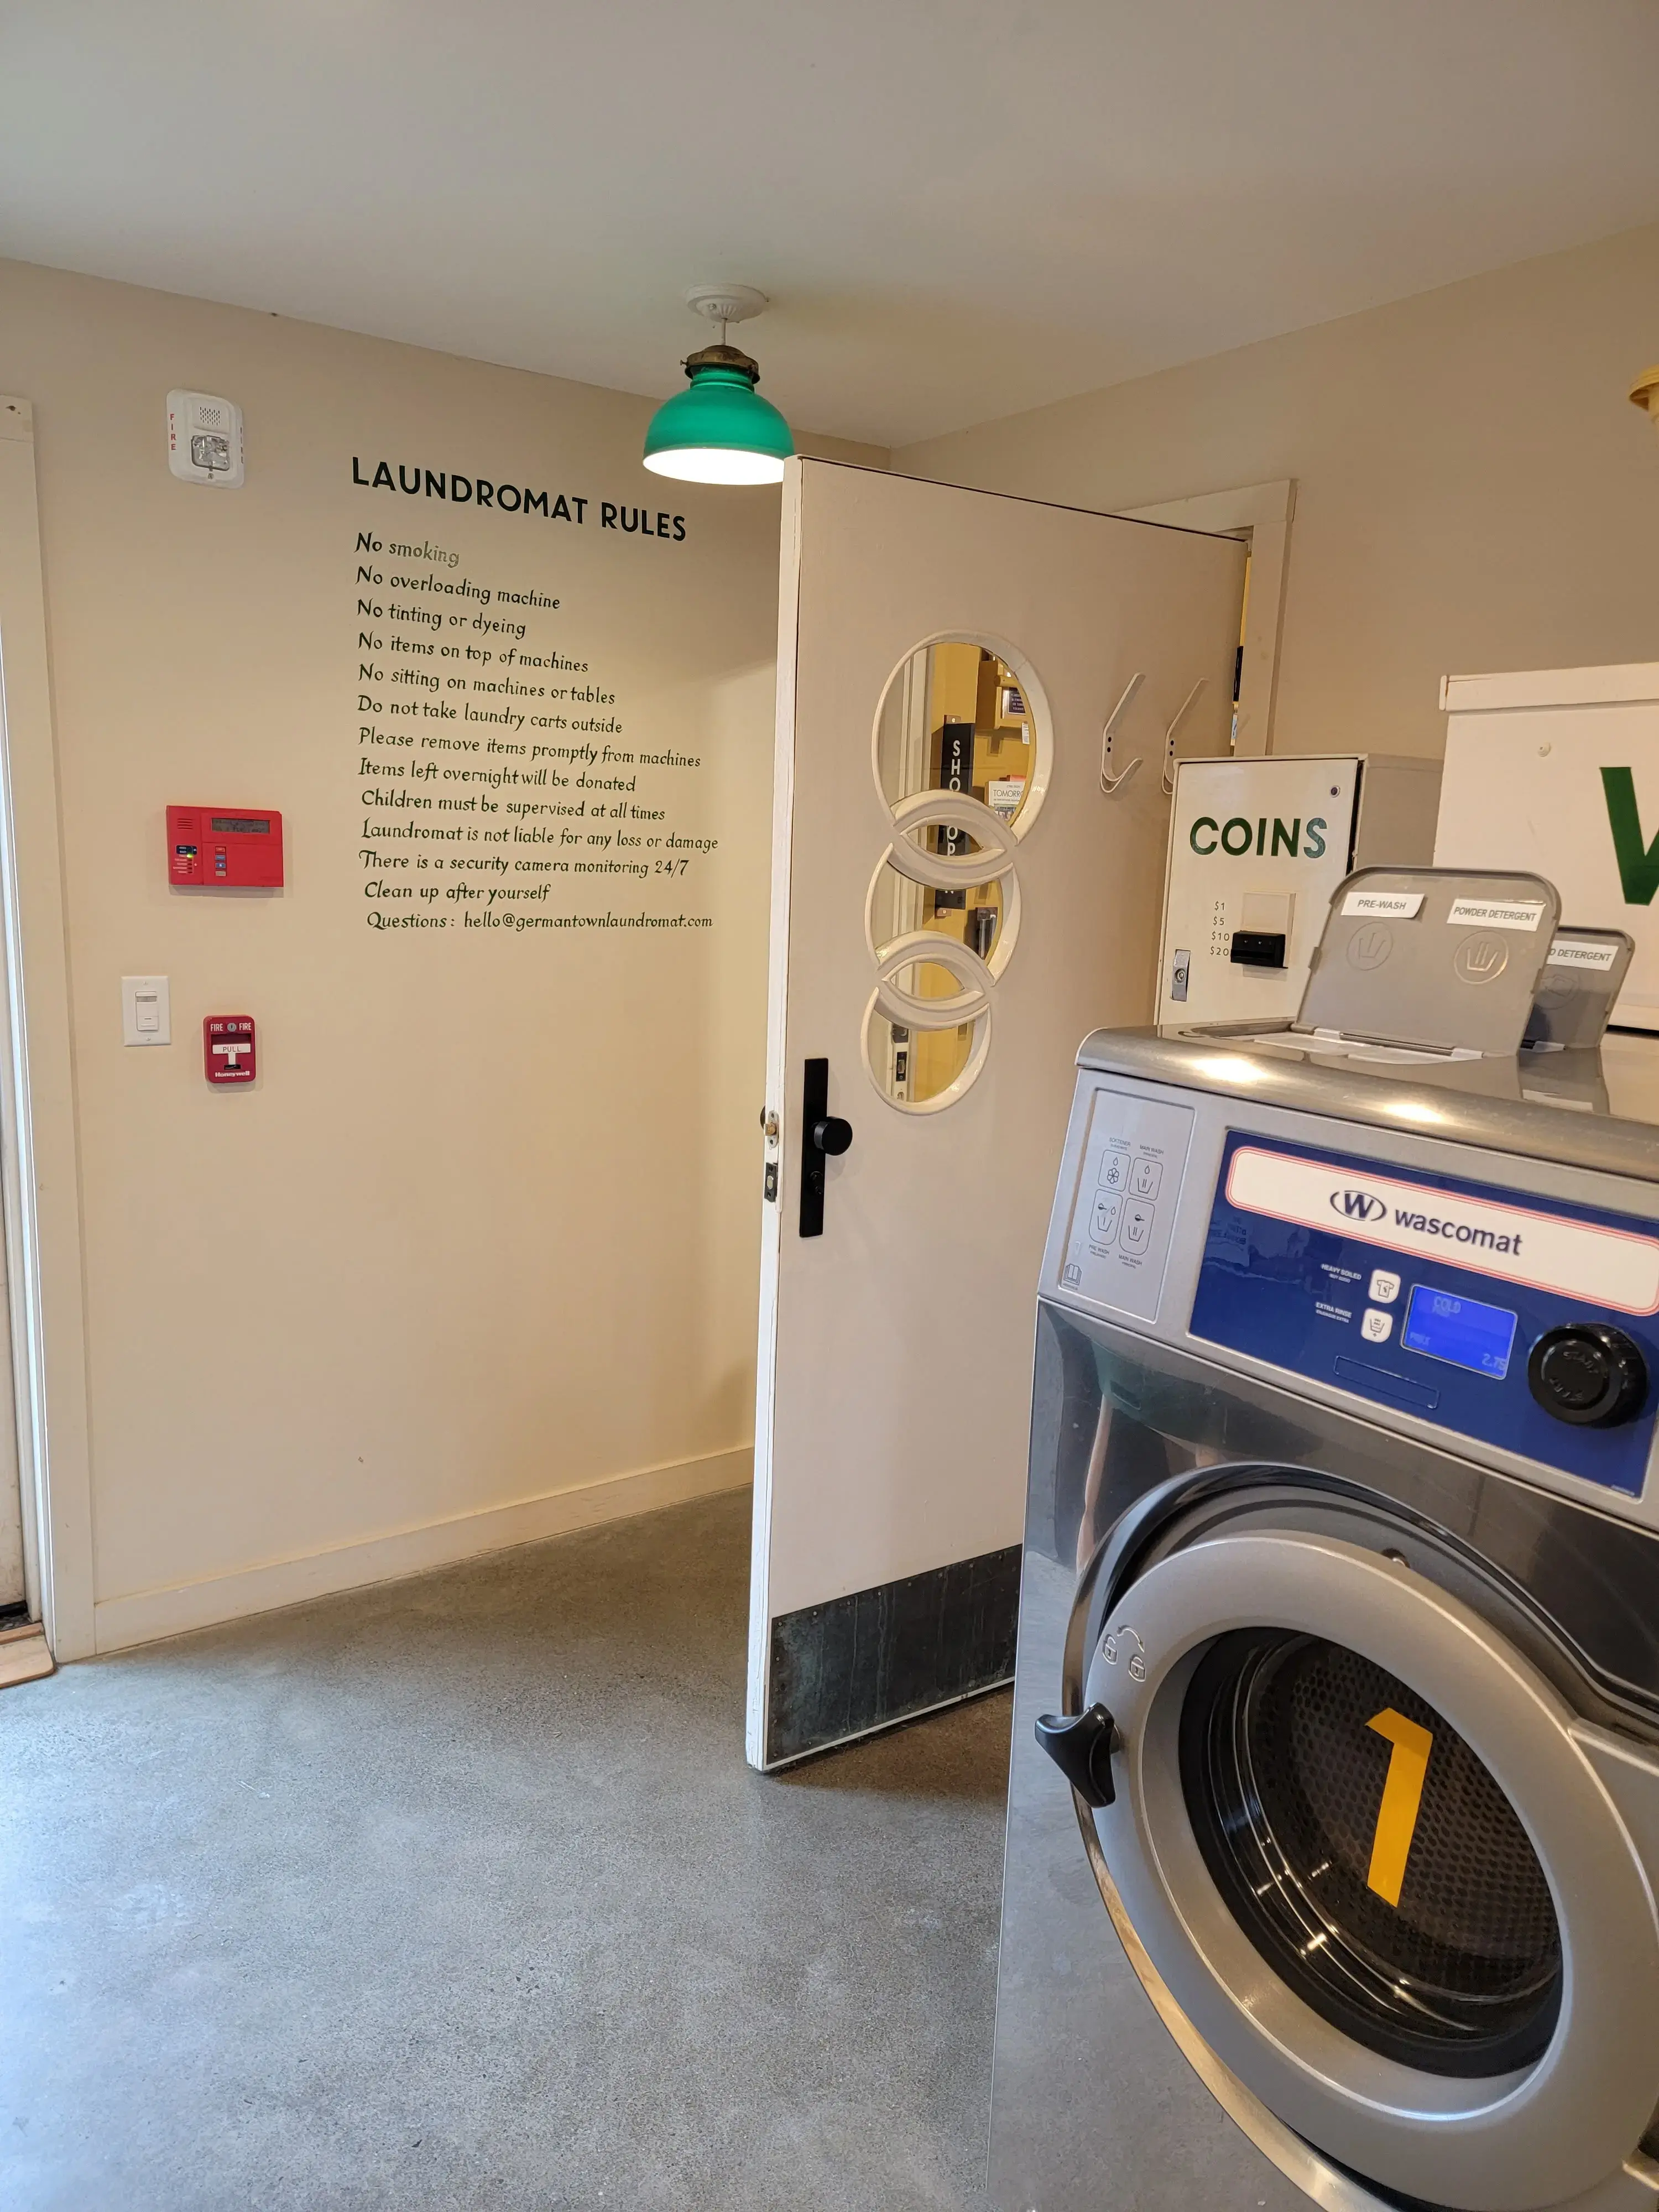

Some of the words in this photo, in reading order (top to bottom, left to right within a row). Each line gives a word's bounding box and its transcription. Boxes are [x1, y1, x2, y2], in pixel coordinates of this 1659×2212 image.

[353, 457, 588, 524] LAUNDROMAT
[602, 502, 686, 541] RULES
[354, 531, 382, 552] No
[389, 541, 459, 568] smoking
[355, 565, 383, 585] No
[390, 573, 491, 606] overloading
[498, 589, 560, 609] machine
[357, 598, 383, 618] No
[388, 604, 442, 631] tinting
[449, 616, 467, 627] or
[473, 612, 526, 640] dyeing
[358, 631, 382, 650] No
[391, 635, 434, 655] items
[441, 646, 459, 658] on
[465, 645, 491, 667] top
[499, 648, 517, 666] of
[520, 651, 588, 672] machines
[358, 663, 383, 681] No
[391, 669, 440, 692] sitting
[447, 679, 466, 690] on
[473, 677, 545, 696] machines
[551, 689, 567, 699] or
[570, 685, 615, 704] tables
[357, 695, 382, 712] Do
[390, 702, 419, 716] not
[422, 701, 457, 718] take
[465, 702, 525, 732] laundry
[531, 715, 567, 729] carts
[572, 717, 623, 733] outside
[358, 726, 413, 747] Please
[421, 738, 480, 751] remove
[487, 738, 526, 754] items
[530, 743, 598, 766] promptly
[601, 745, 634, 764] from
[640, 749, 701, 766] machines
[358, 758, 405, 776] Items
[411, 760, 439, 782] left
[444, 766, 519, 789] overnight
[521, 768, 547, 785] will
[552, 770, 568, 786] be
[576, 771, 636, 791] donated
[949, 740, 961, 791] SHO
[362, 788, 432, 808] Children
[439, 796, 478, 811] must
[481, 794, 498, 812] be
[507, 801, 585, 821] supervised
[591, 804, 606, 817] at
[610, 802, 627, 818] all
[630, 805, 665, 820] times
[361, 817, 464, 841] Laundromat
[467, 827, 478, 841] is
[484, 828, 510, 842] not
[514, 826, 554, 843] liable
[558, 828, 582, 847] for
[587, 835, 612, 852] any
[617, 830, 641, 846] loss
[647, 838, 662, 847] or
[666, 832, 718, 854] damage
[1190, 816, 1327, 859] COINS
[359, 850, 409, 869] There
[417, 854, 428, 869] is
[435, 859, 444, 869] a
[450, 857, 509, 876] security
[515, 861, 568, 872] camera
[575, 860, 649, 878] monitoring
[655, 858, 690, 878] 24/7
[365, 879, 412, 898] Clean
[420, 888, 439, 905] up
[446, 882, 484, 904] after
[486, 884, 551, 906] yourself
[1214, 901, 1225, 911] $1
[1357, 899, 1407, 910] PRE-WASH
[465, 911, 713, 932] hello@germantownlaundromat.com
[1213, 916, 1224, 926] $5
[1453, 906, 1487, 918] POWDER
[1489, 910, 1537, 922] DETERGENT
[1210, 946, 1229, 956] $20
[1211, 931, 1230, 941] $10
[1557, 950, 1613, 961] DETERGENT
[210, 1024, 223, 1032] FIRE
[239, 1022, 252, 1031] FIRE
[1395, 1209, 1523, 1256] wascomat
[1321, 1264, 1340, 1274] HEAVY
[1316, 1301, 1334, 1312] EXTRA
[1334, 1308, 1353, 1318] RINSE
[1365, 1707, 1433, 1908] 1
